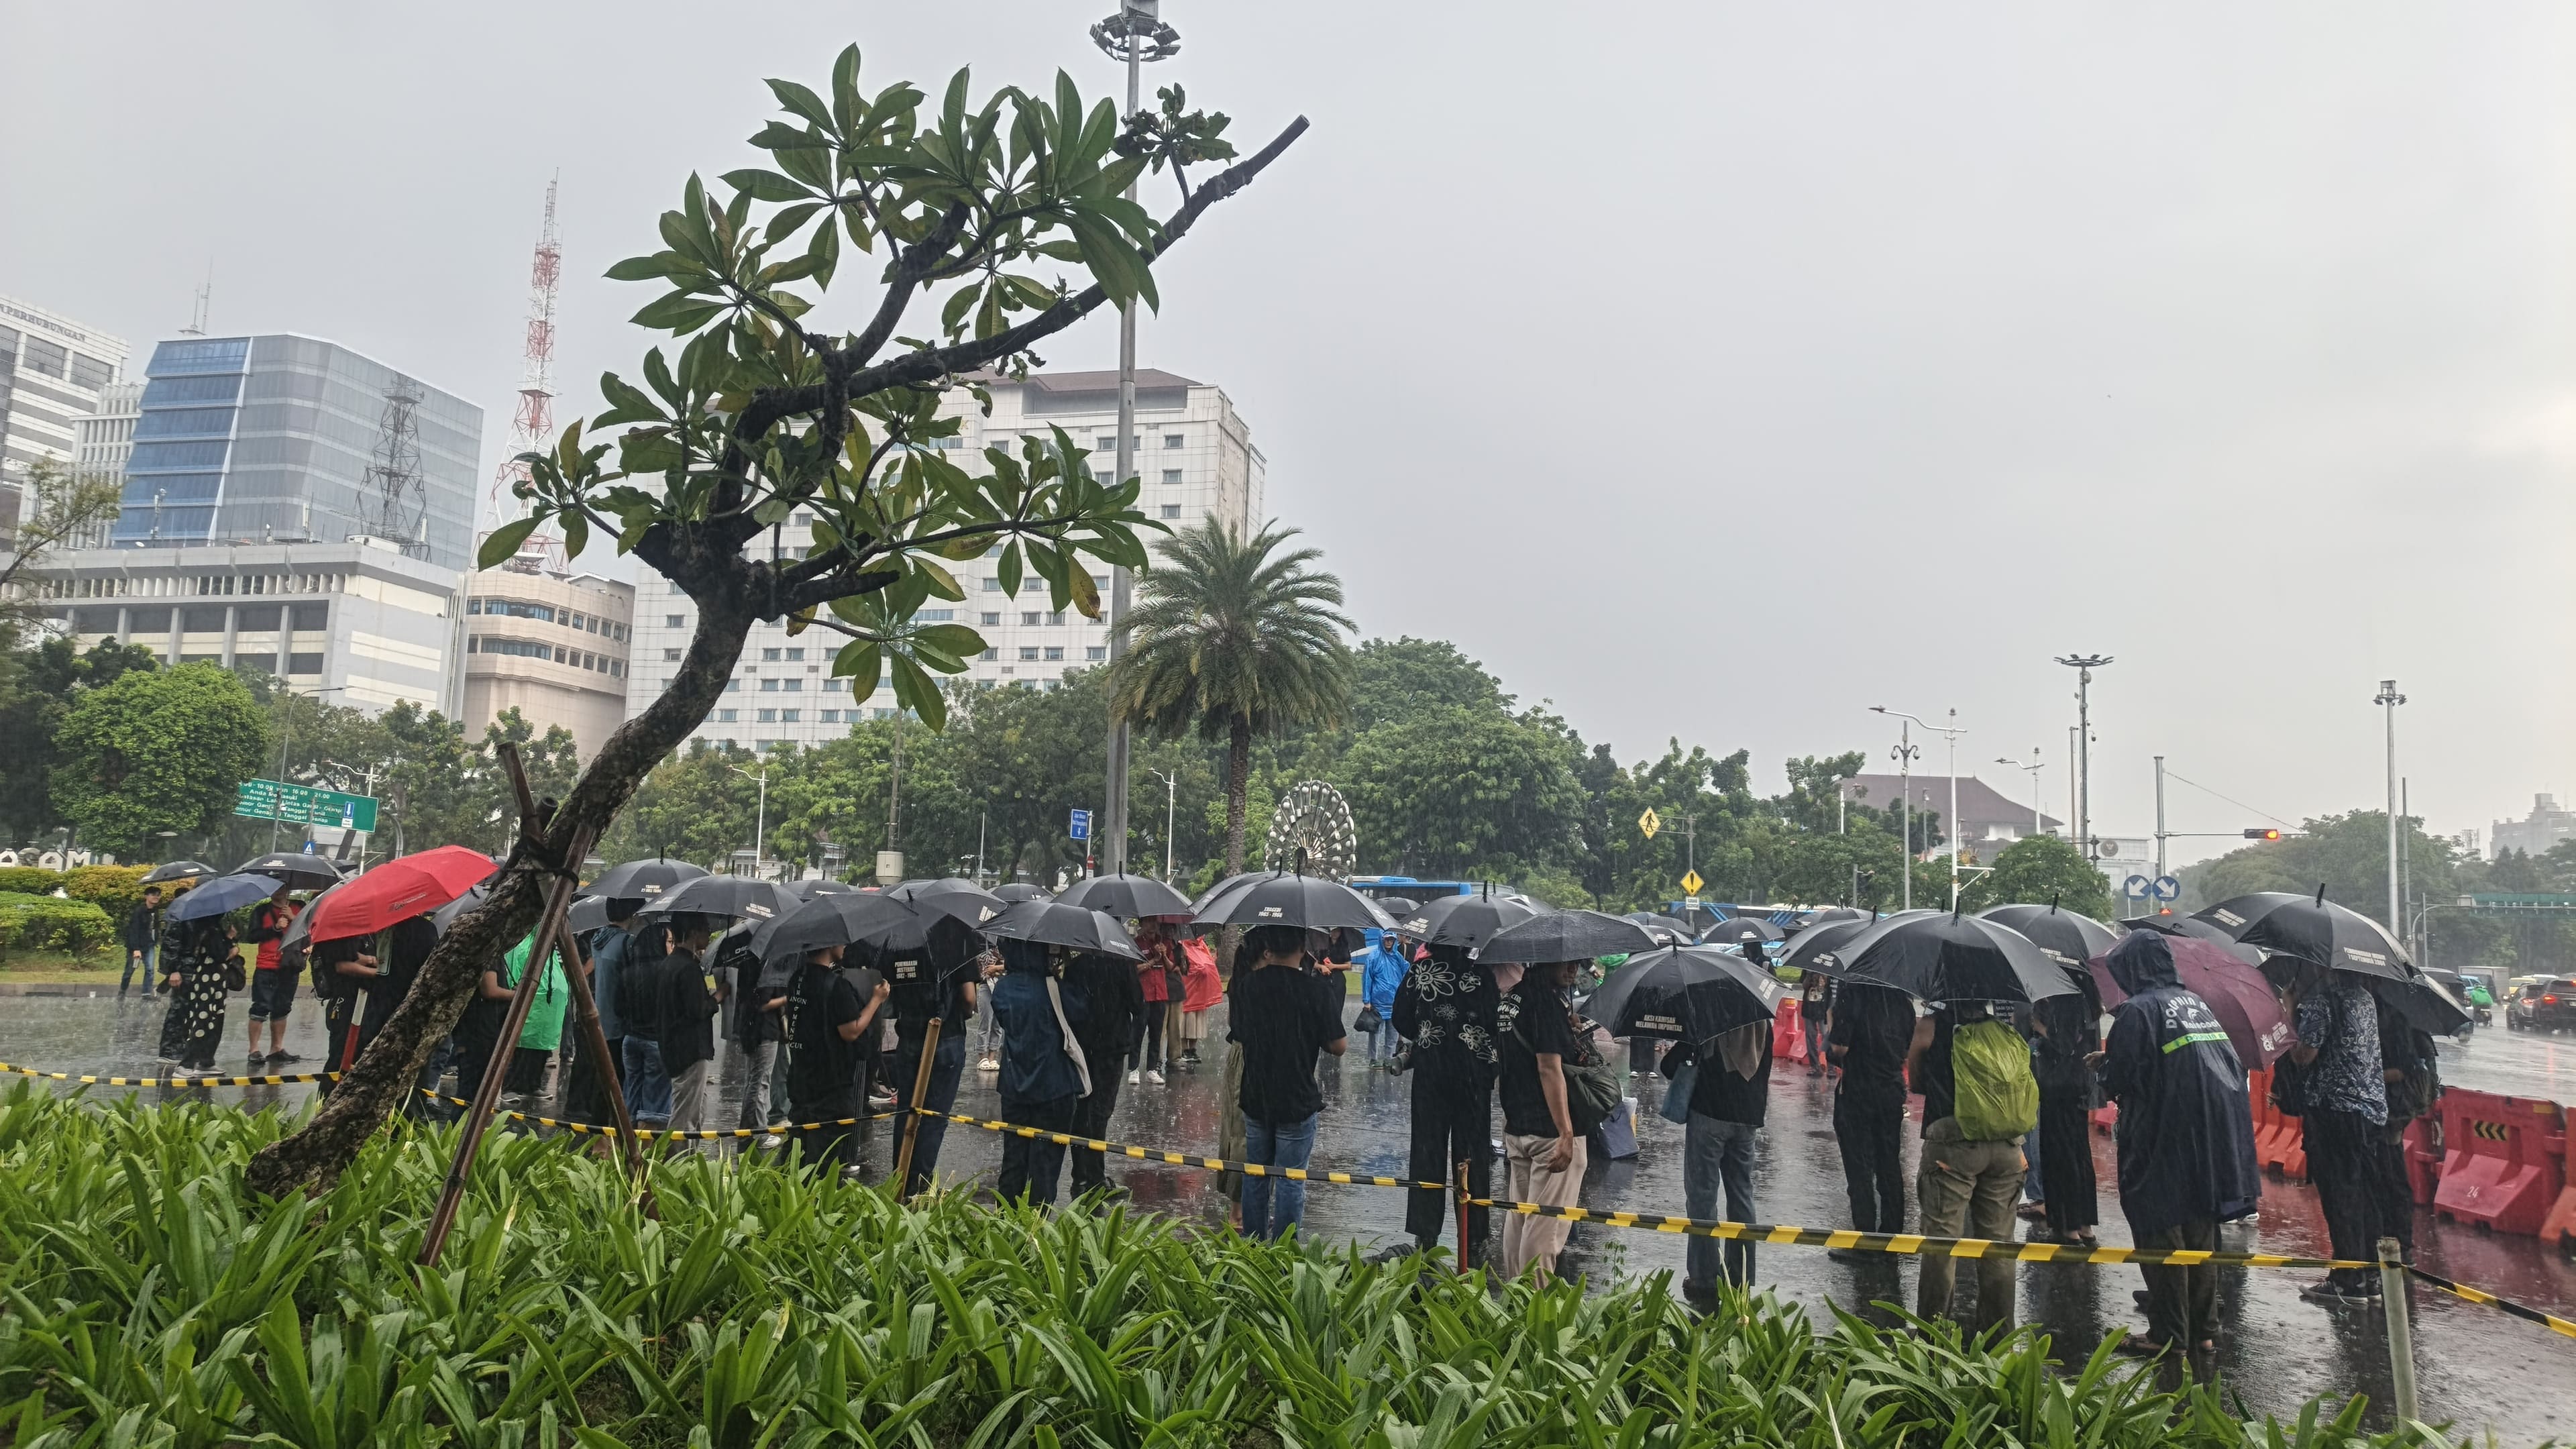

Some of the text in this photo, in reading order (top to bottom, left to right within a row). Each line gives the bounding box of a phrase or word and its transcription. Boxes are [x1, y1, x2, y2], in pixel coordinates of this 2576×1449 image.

[6, 305, 87, 342] PERHUBUNGAN
[2165, 996, 2197, 1028] DOLPHIN
[2467, 1185, 2480, 1199] 24
